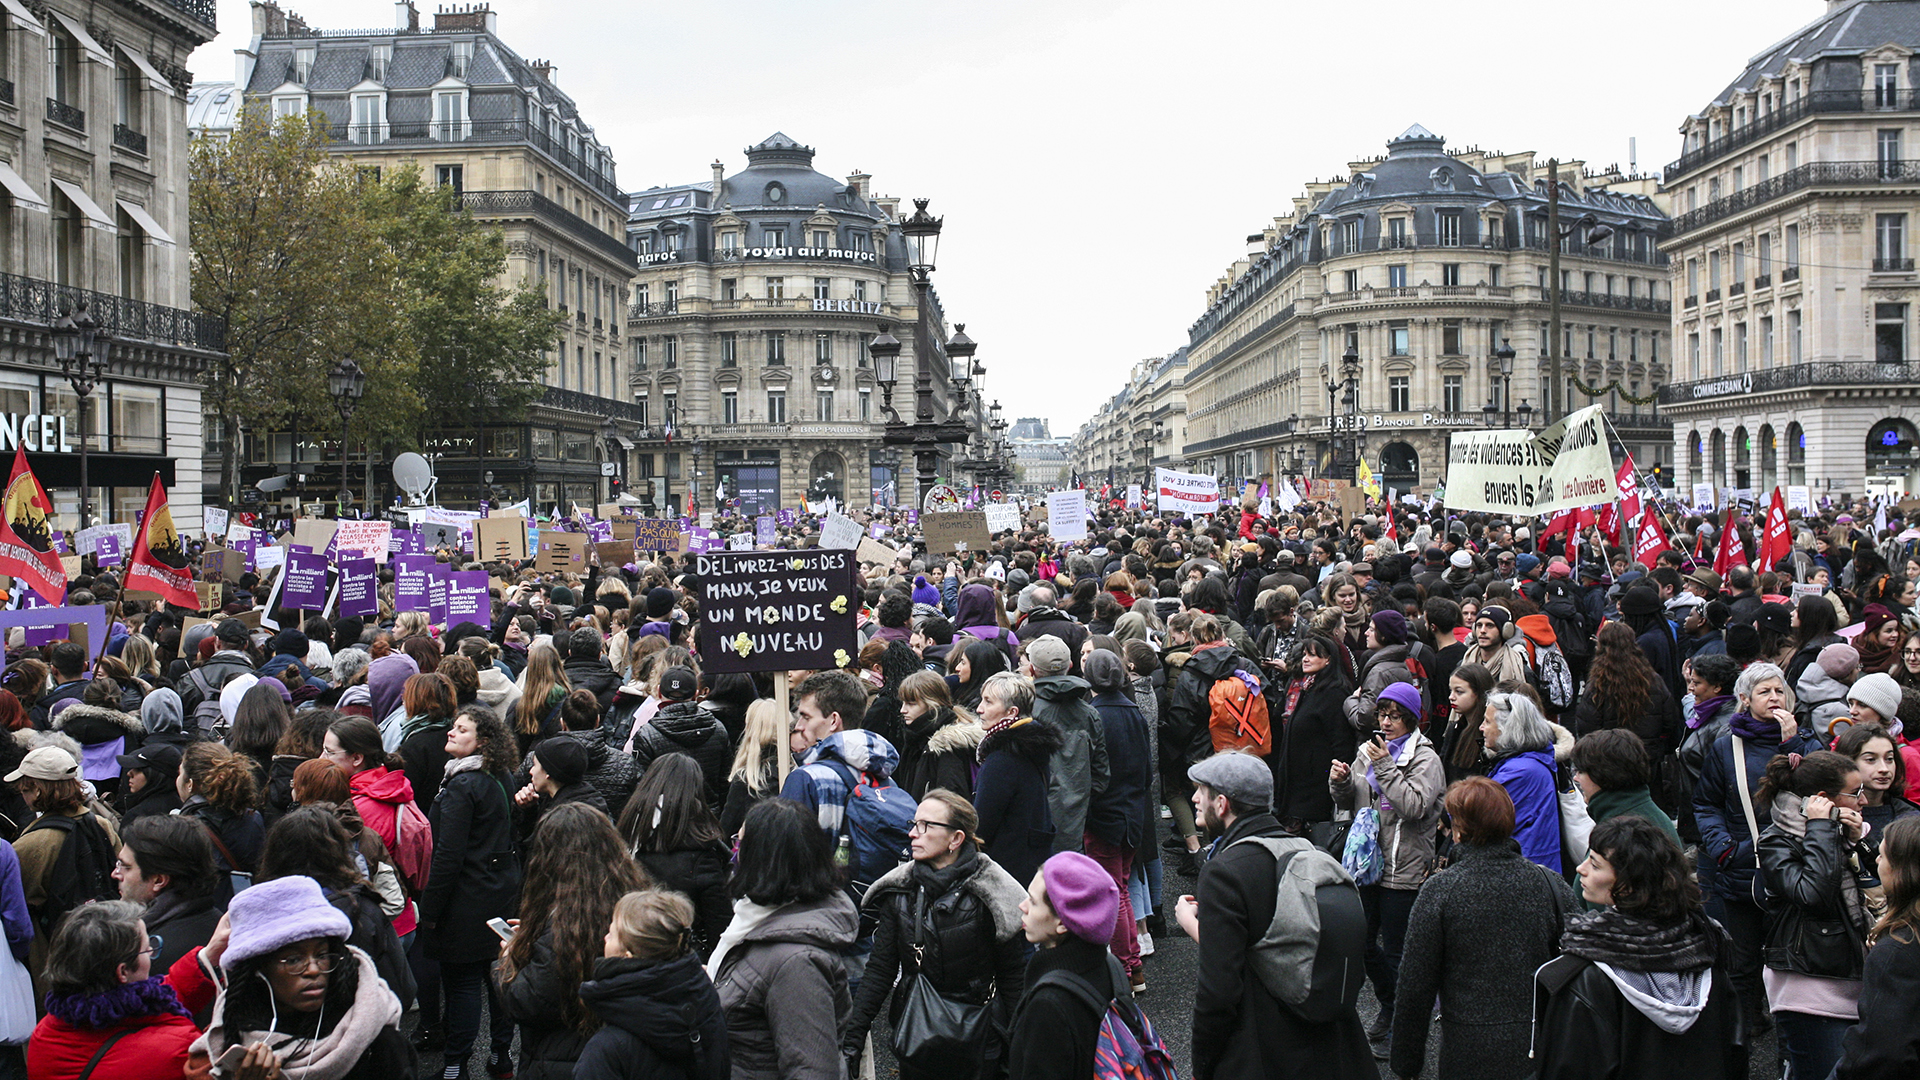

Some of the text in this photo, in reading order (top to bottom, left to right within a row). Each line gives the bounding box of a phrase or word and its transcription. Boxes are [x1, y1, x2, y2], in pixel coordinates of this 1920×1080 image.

[743, 247, 875, 262] royal air maroc
[813, 299, 884, 315] BERLITZ
[1693, 379, 1743, 398] COMMERZBANK
[1373, 414, 1415, 427] BANQUE
[1422, 413, 1475, 426] POPULAIRE
[296, 440, 342, 448] MATY
[425, 438, 475, 447] MATY
[1467, 435, 1478, 464] les
[1481, 435, 1523, 466] violences
[1484, 480, 1518, 505] envers
[1573, 474, 1607, 497] Ouvrière
[636, 520, 647, 528] JE
[650, 520, 661, 528] NE
[663, 520, 680, 530] SUIS
[640, 527, 658, 537] PAS
[938, 521, 973, 530] HOMMES
[635, 536, 671, 550] CHATTE
[730, 535, 740, 545] PAS
[740, 534, 751, 545] UNE
[204, 552, 224, 572] LE 8
[289, 560, 325, 576] 1 milliard
[399, 562, 409, 576] 1
[821, 553, 845, 571] DES
[342, 568, 373, 582] 1 milliard
[427, 573, 436, 587] 1
[449, 580, 486, 594] 1 milliard
[787, 577, 828, 592] VEUX
[28, 597, 38, 609] 1
[708, 603, 825, 625] UN MONDE
[720, 631, 823, 655] NUVEAU
